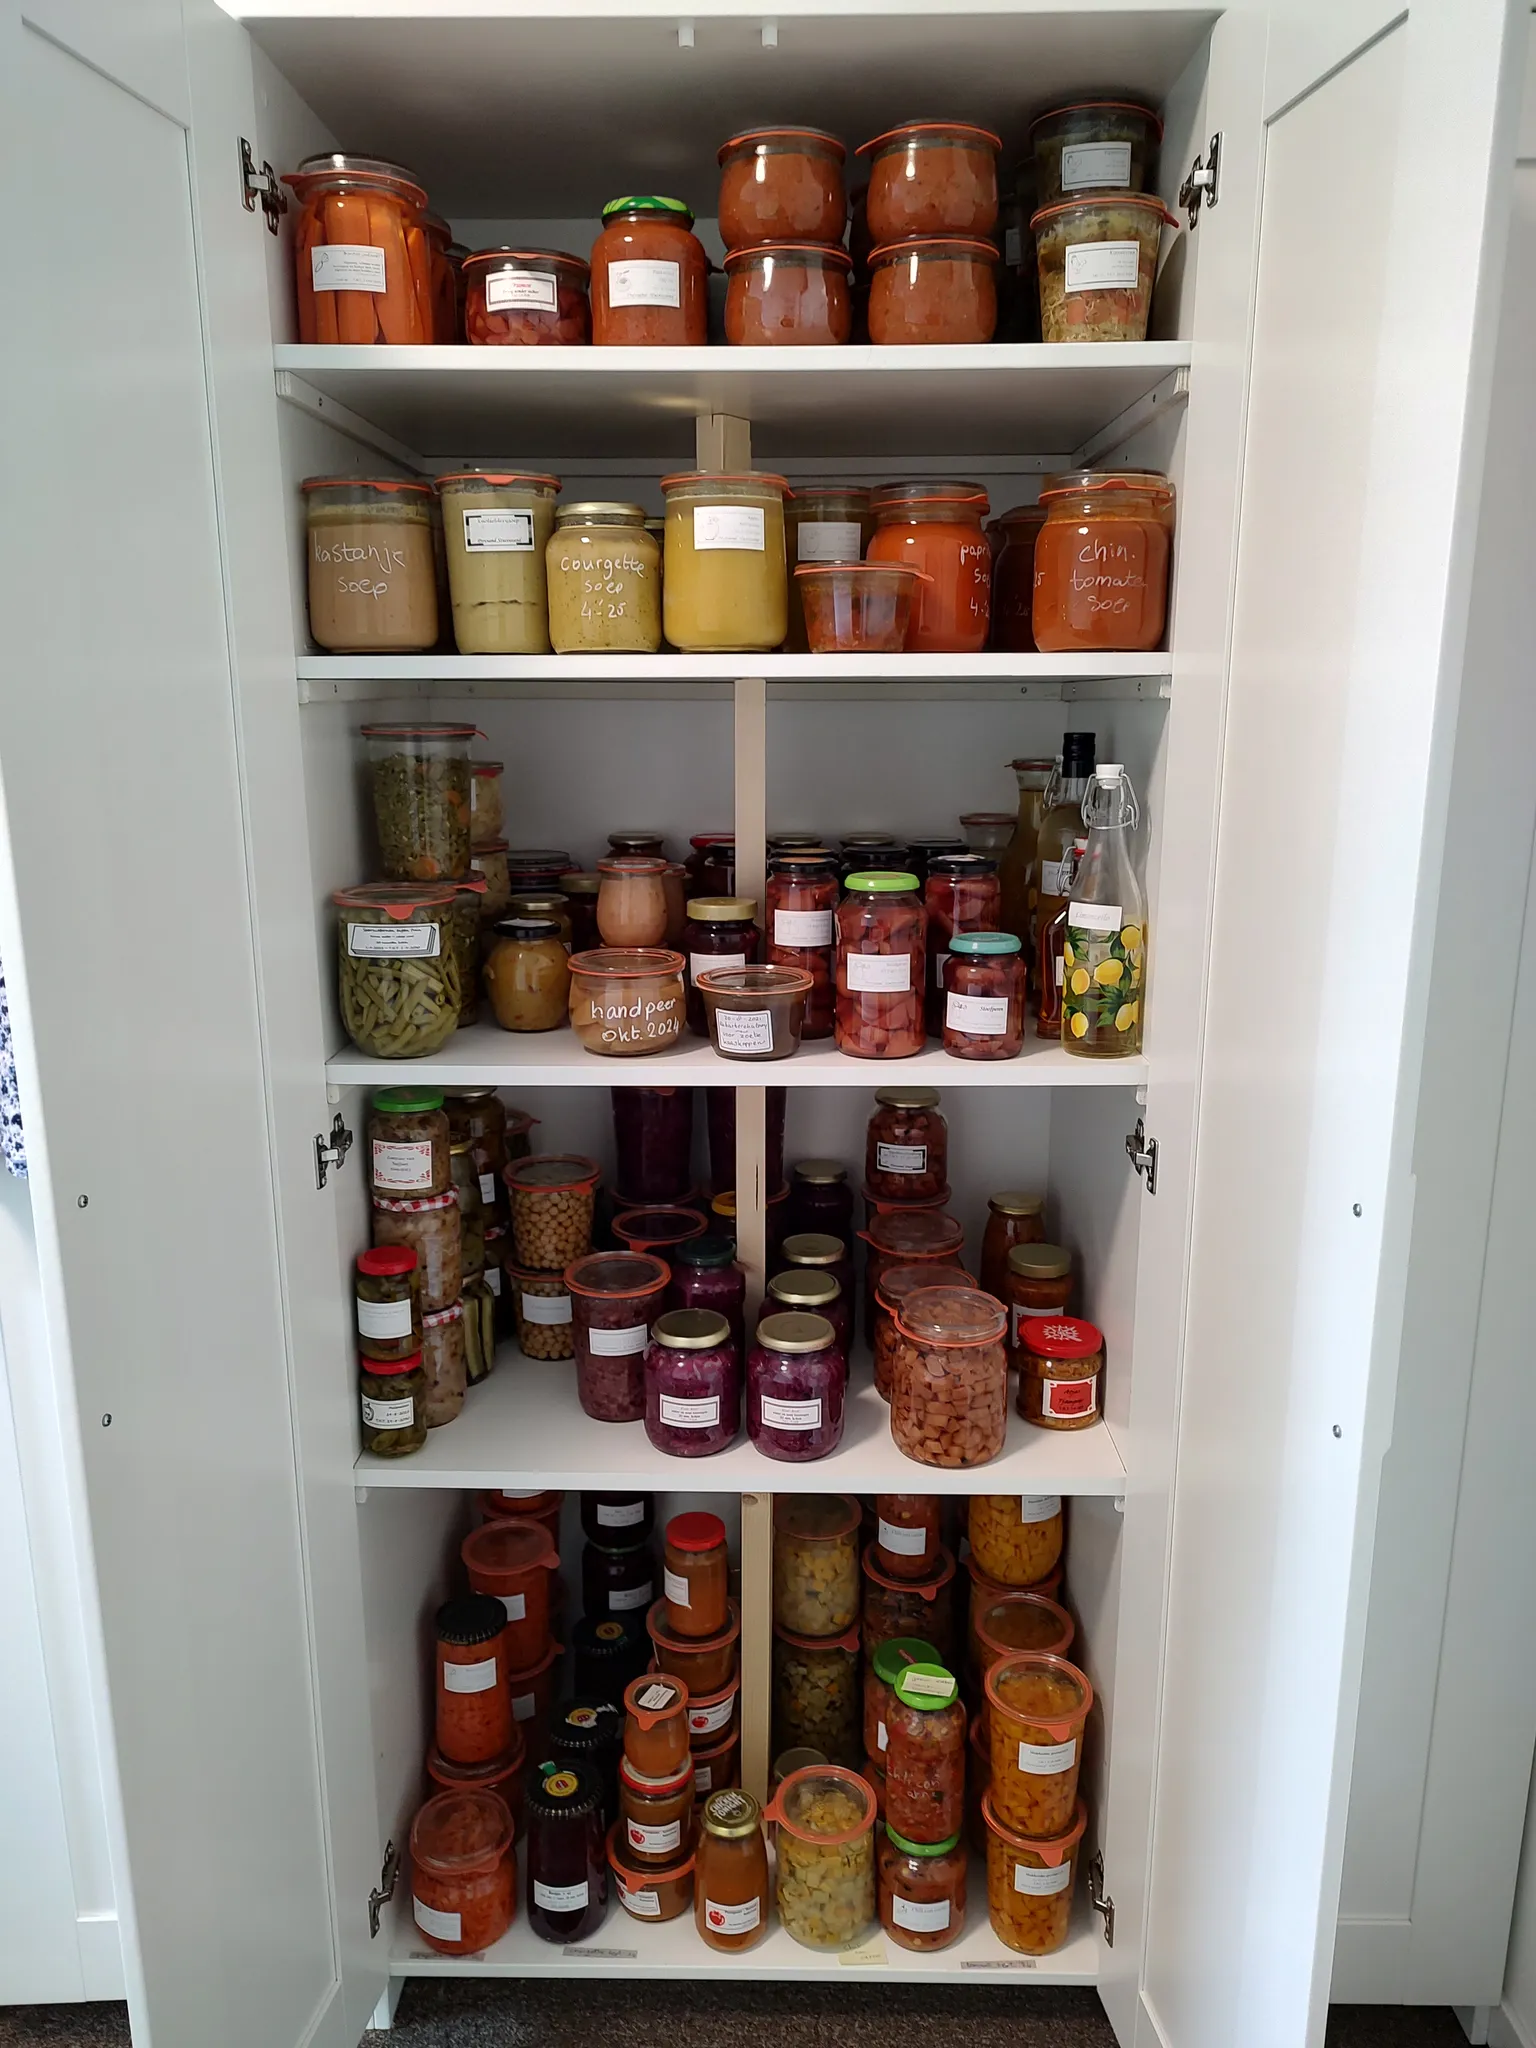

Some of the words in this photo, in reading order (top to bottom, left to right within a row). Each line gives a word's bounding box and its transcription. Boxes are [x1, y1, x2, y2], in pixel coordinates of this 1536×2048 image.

[338, 577, 388, 600] soep
[585, 580, 624, 594] soep
[647, 1016, 679, 1038] 2024
